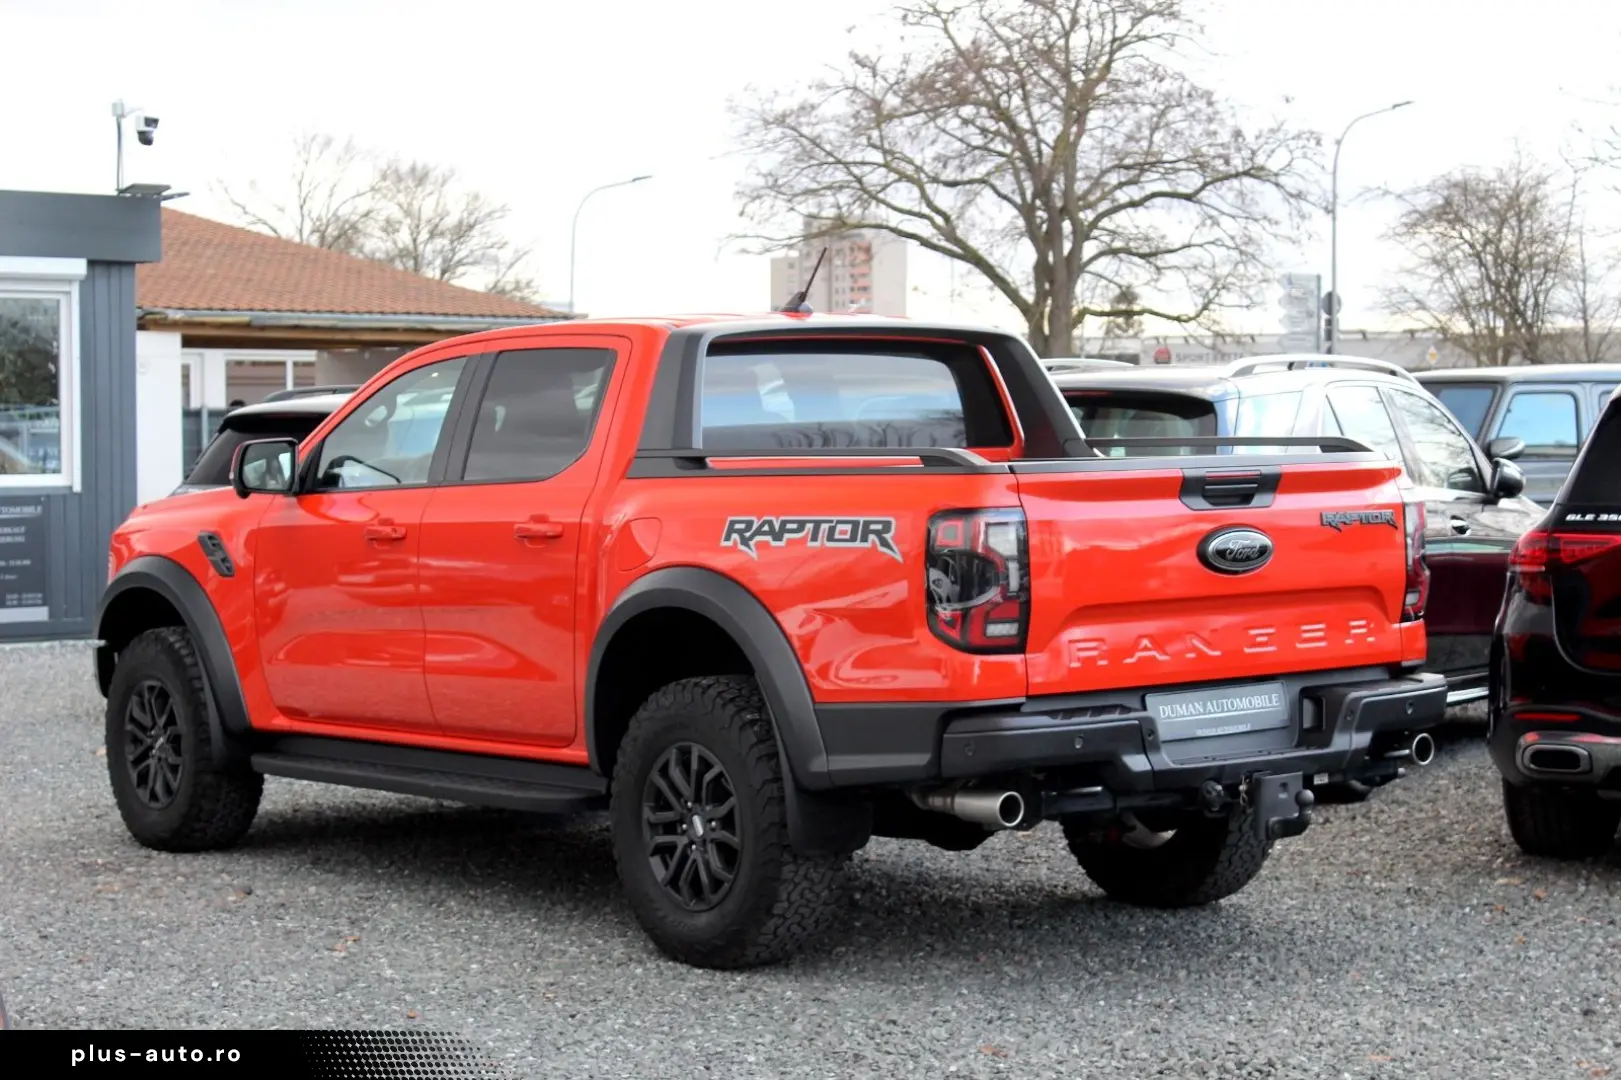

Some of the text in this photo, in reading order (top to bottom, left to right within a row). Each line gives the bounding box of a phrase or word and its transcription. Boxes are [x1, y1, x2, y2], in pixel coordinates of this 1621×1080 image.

[1320, 510, 1398, 532] RAPTOR
[1565, 513, 1596, 521] GLE
[720, 515, 903, 563] RAPTOR
[1226, 539, 1260, 560] Ford
[1067, 619, 1376, 668] RANGER
[1158, 693, 1281, 718] DUMAN AUTOMOBILE
